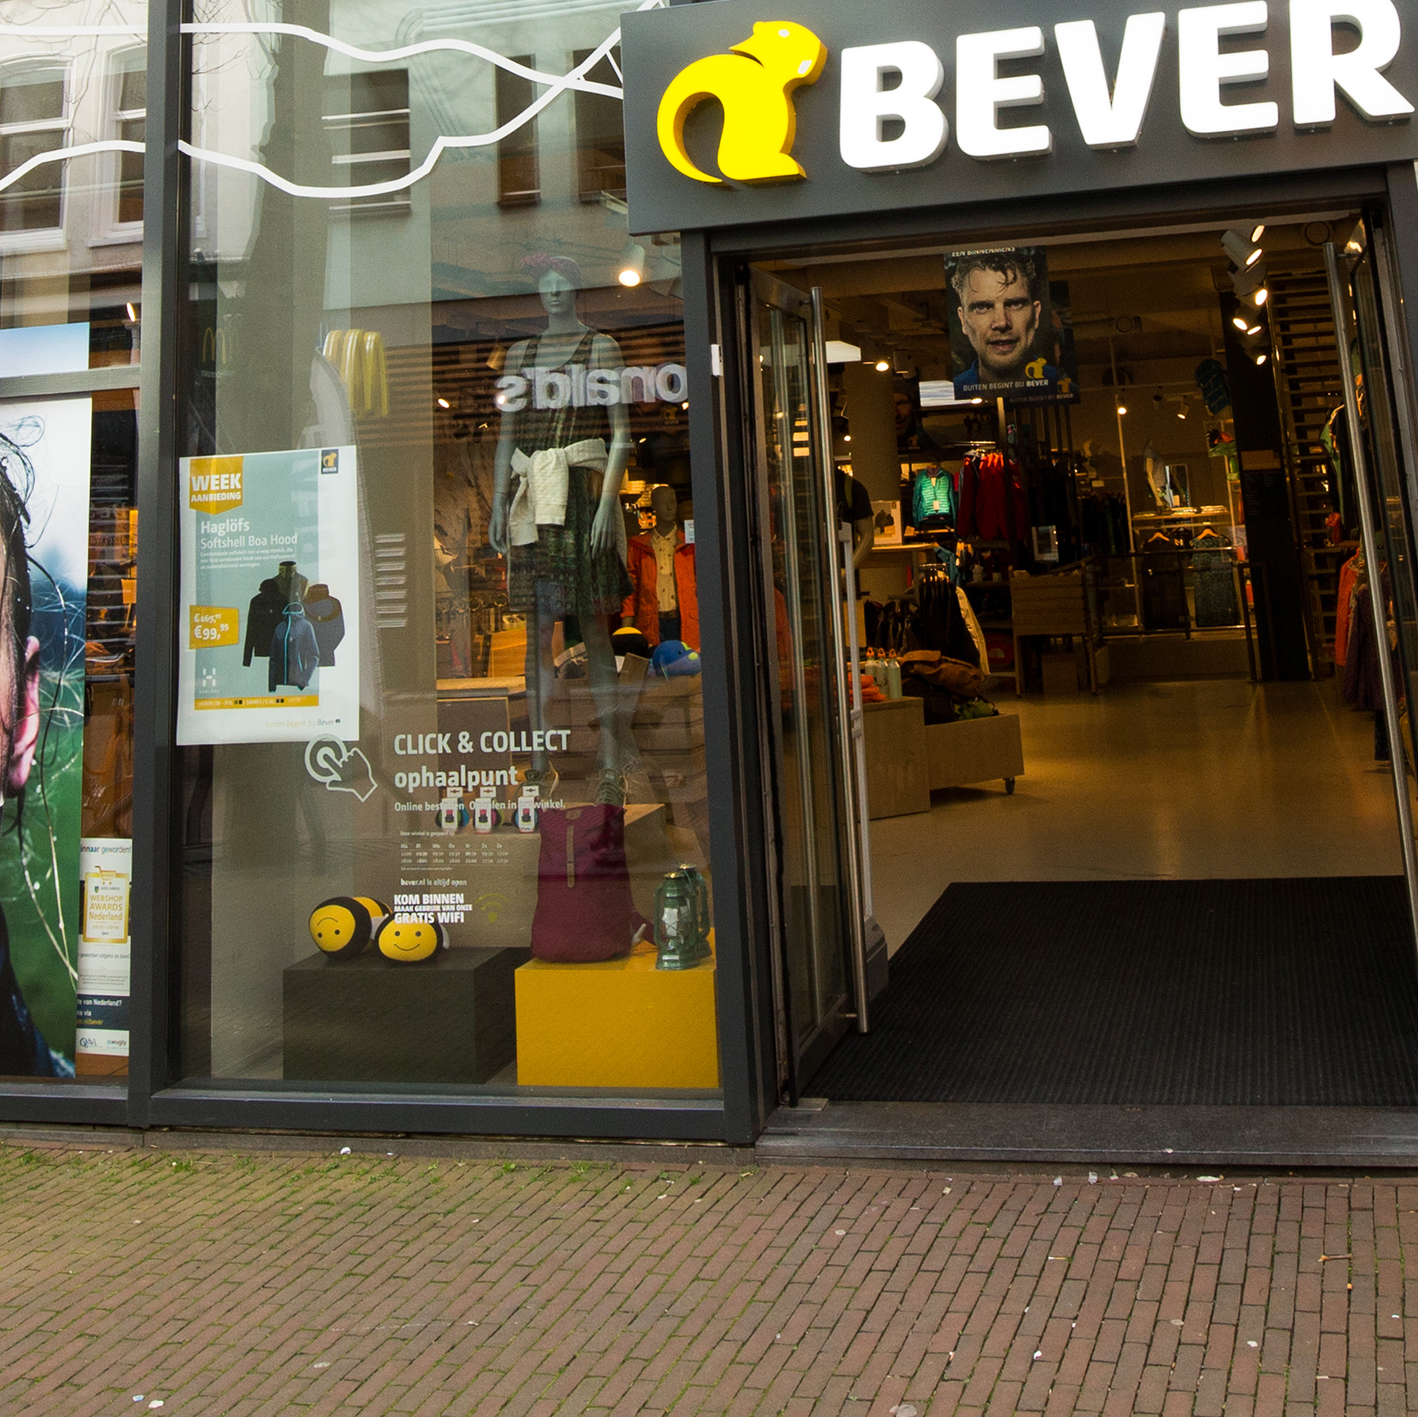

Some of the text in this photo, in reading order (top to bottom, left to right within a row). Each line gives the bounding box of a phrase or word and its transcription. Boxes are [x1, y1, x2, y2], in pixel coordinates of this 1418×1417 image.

[963, 380, 1049, 392] BUITEN BEGINT BIJ BEVER
[191, 473, 242, 492] WEEK
[191, 491, 242, 502] AANBIEDING
[201, 518, 250, 537] Haglöfs
[201, 533, 298, 549] Softshell Boa Hood
[394, 730, 571, 755] CLICK & COLLECT
[394, 765, 518, 793] ophaalpunt
[394, 802, 423, 812] Online
[533, 799, 566, 809] winkel.
[394, 893, 464, 905] KOM BINNEN
[89, 903, 123, 911] AWARDS
[89, 911, 123, 921] Nederland
[394, 912, 464, 924] GRATIS WIFI
